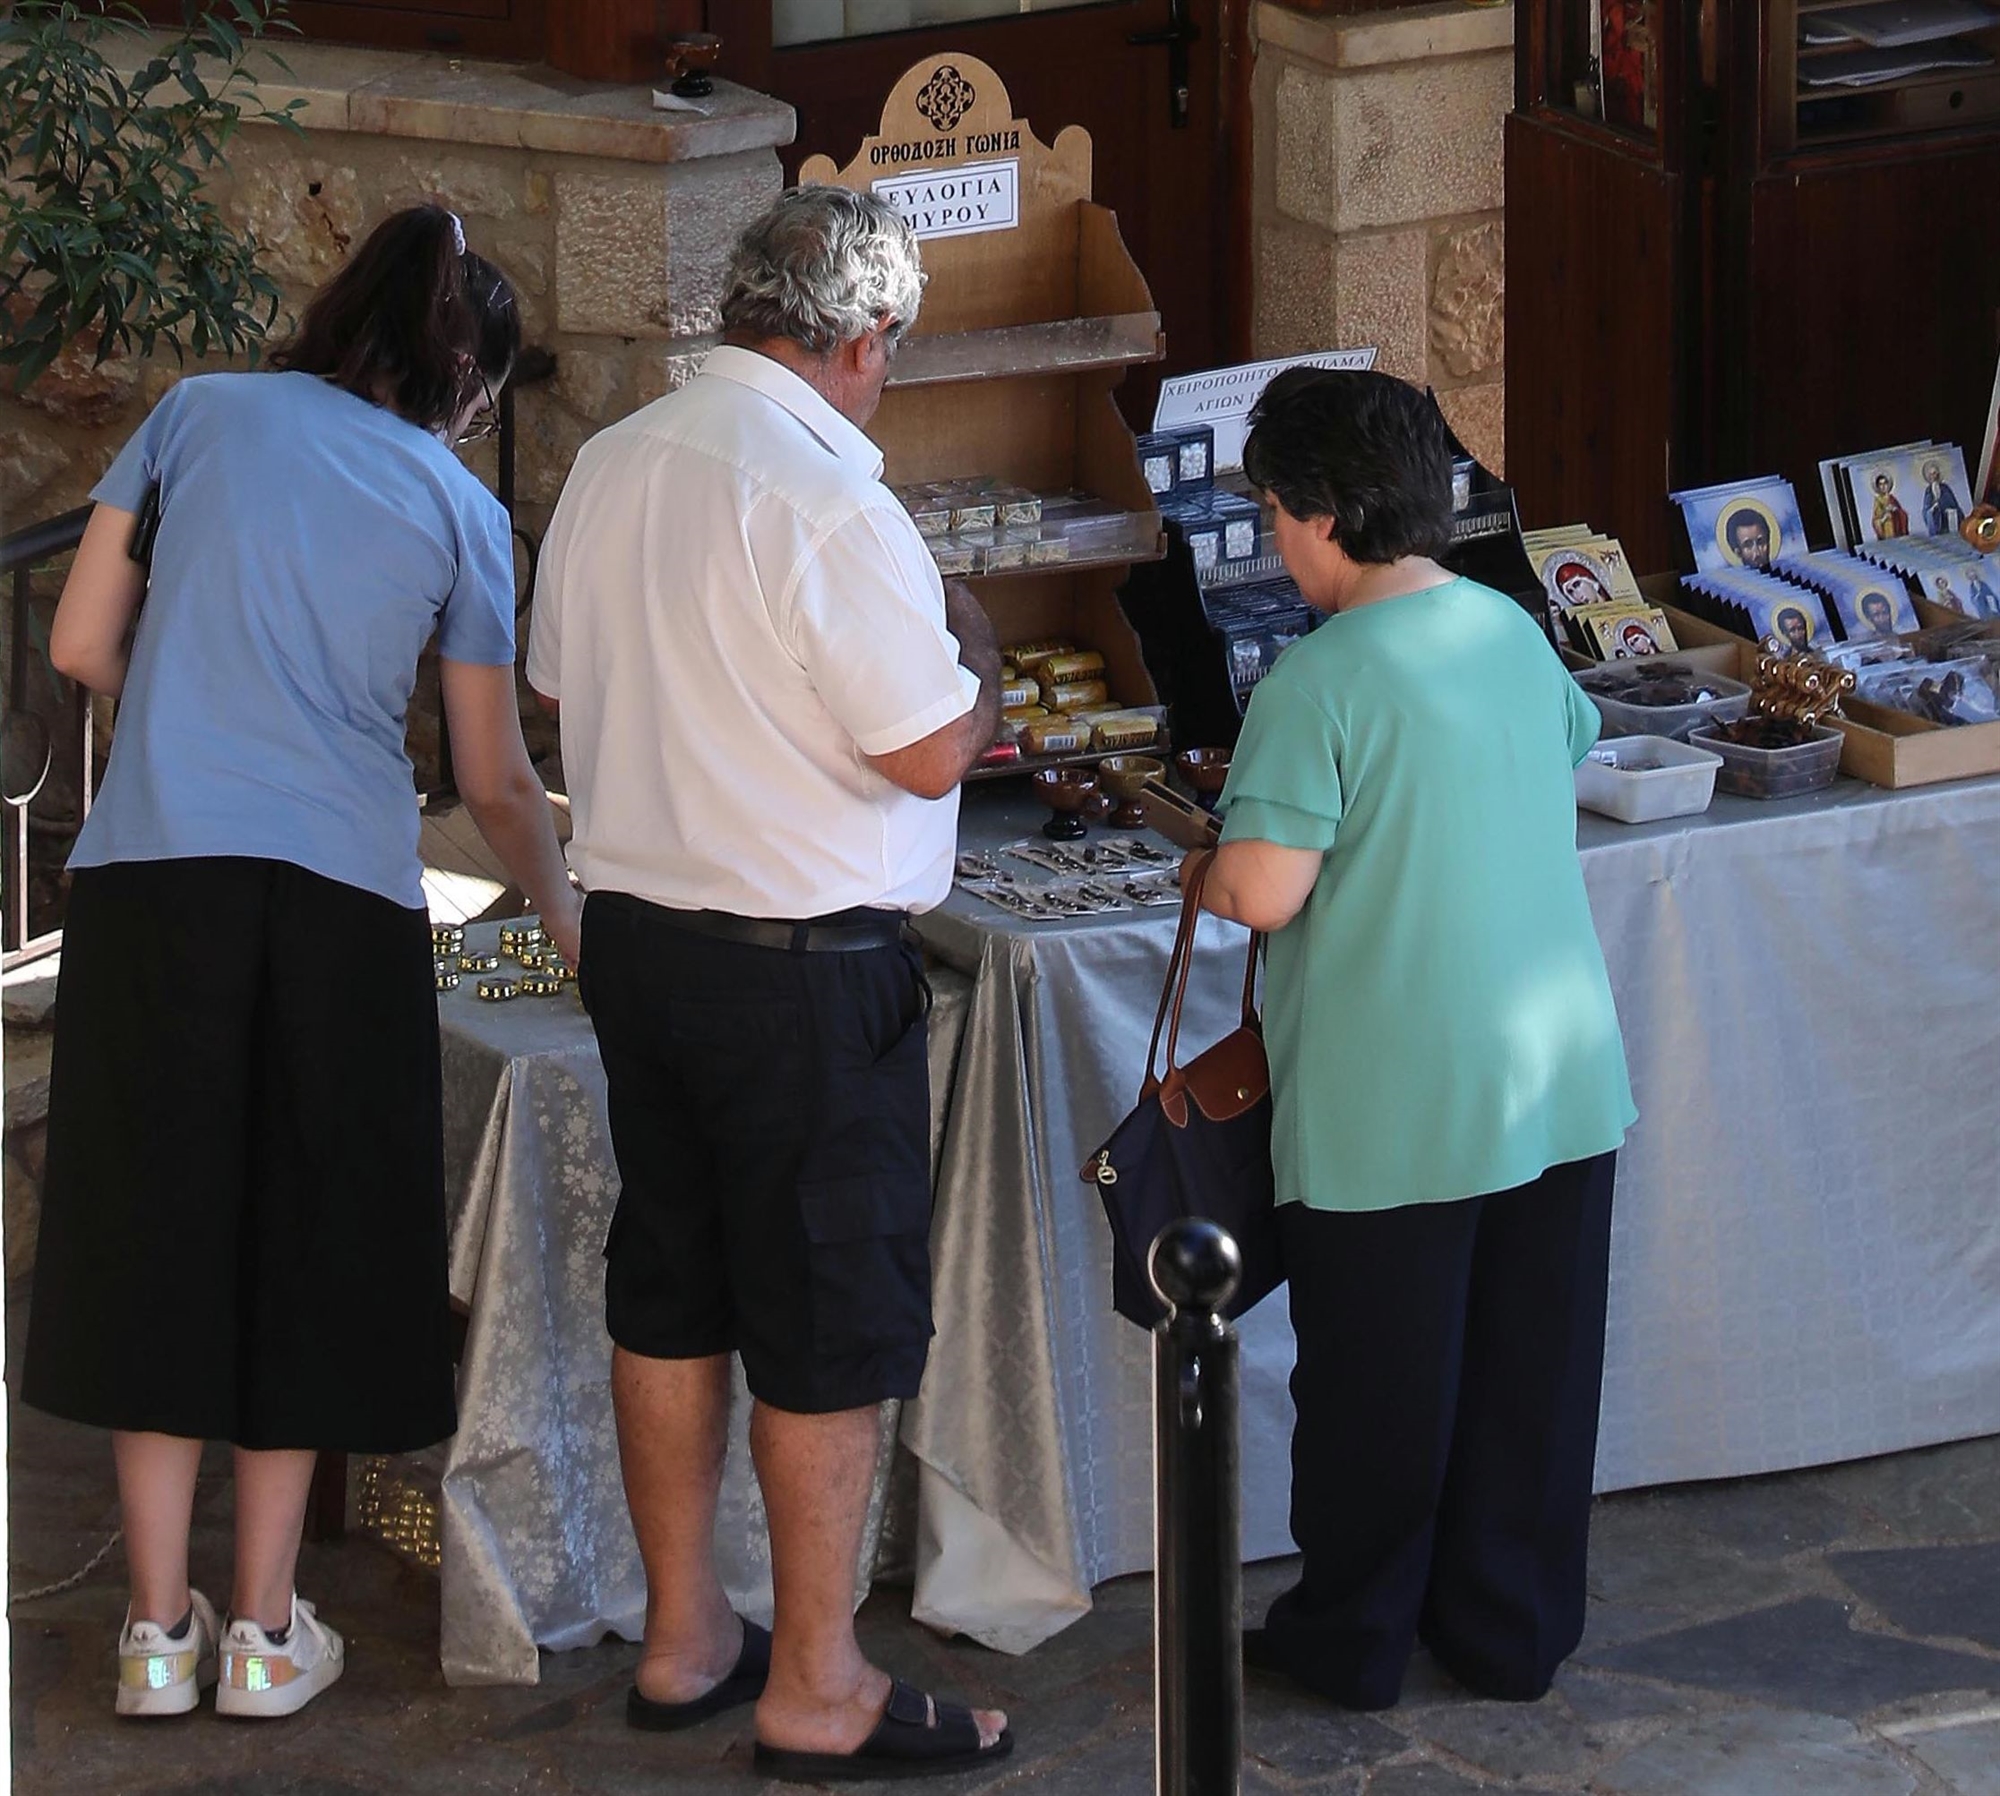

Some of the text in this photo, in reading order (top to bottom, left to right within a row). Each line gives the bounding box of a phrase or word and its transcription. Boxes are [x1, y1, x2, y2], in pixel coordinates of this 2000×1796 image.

[870, 137, 956, 165] ΟΡΘΟΔΟΞΗ
[889, 178, 1001, 207] ΕΥΛΟΓΙΑ
[902, 203, 989, 230] ΜΥΡΟΥ
[1194, 394, 1244, 413] ΑΓΙΩΝ
